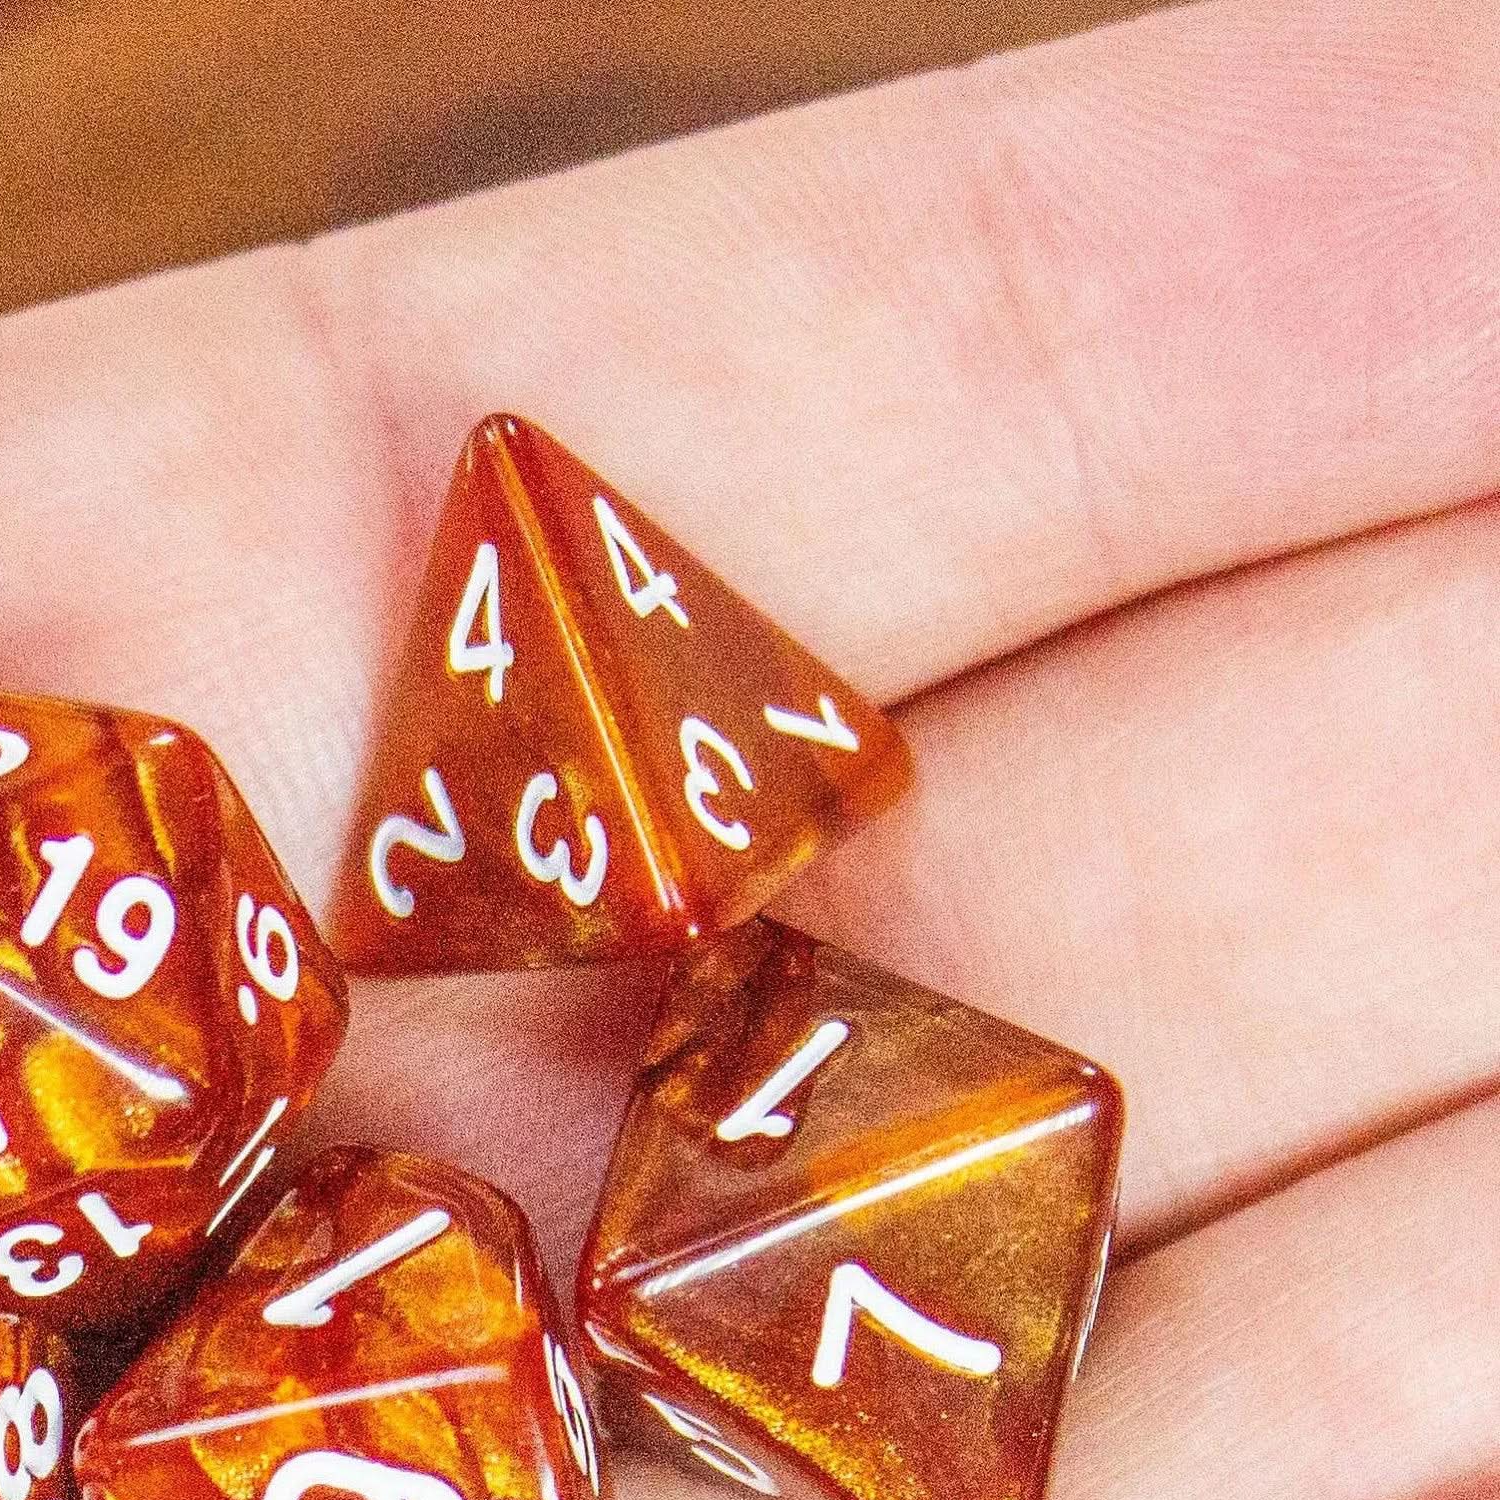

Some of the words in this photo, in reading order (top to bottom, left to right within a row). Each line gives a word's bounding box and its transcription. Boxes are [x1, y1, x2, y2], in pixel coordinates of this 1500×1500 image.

[448, 541, 516, 703] 4
[595, 496, 690, 628] 4
[678, 714, 754, 851] 3
[763, 693, 861, 752] 1
[369, 767, 466, 918] 2
[515, 771, 609, 907] 3
[18, 832, 177, 1000] 19
[715, 1018, 850, 1142] 1
[261, 1207, 452, 1328] 1
[810, 1261, 1003, 1388] 7
